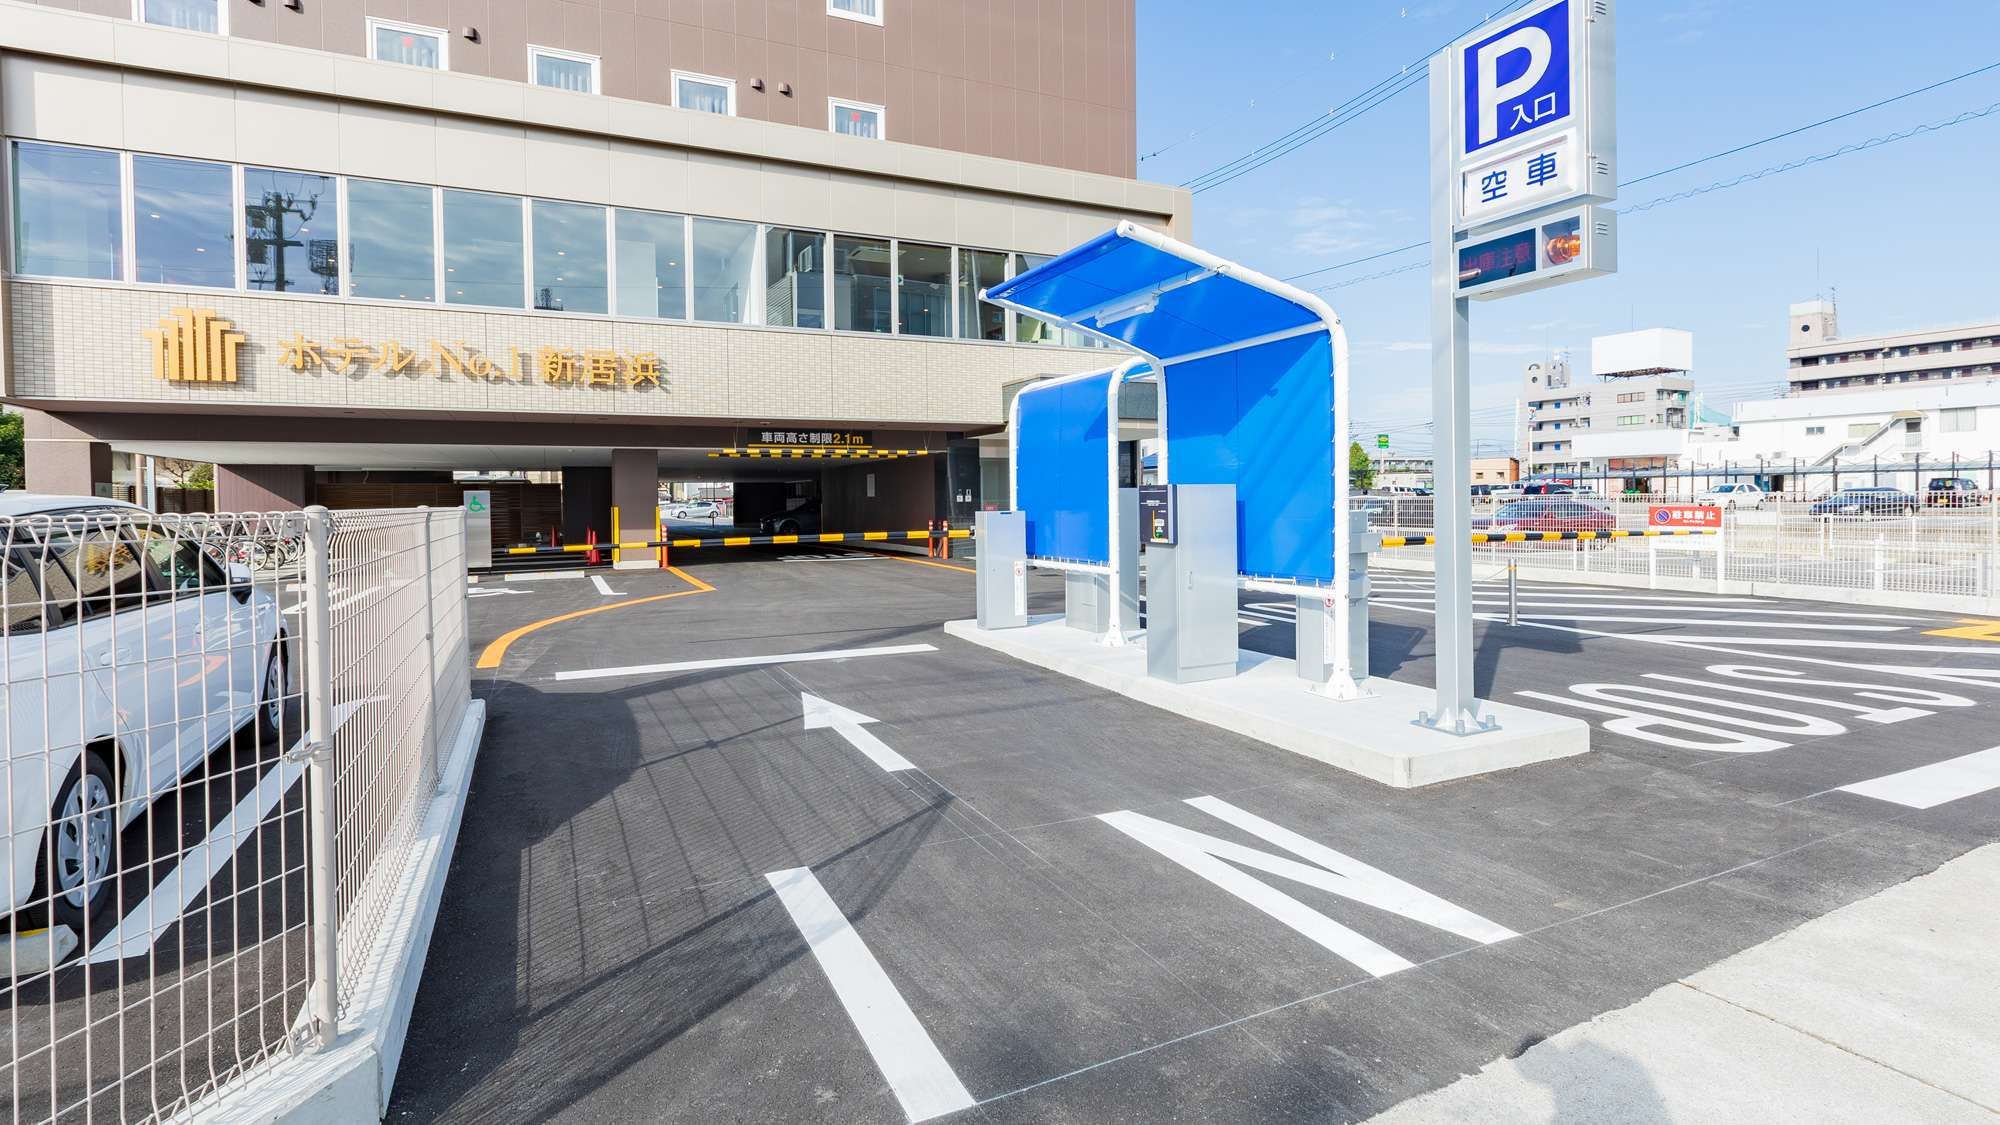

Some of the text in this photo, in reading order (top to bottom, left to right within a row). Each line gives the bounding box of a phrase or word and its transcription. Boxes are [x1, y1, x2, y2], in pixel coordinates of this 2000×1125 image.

[1477, 26, 1553, 146] P
[1510, 92, 1557, 131] 入口
[1481, 151, 1558, 203] 空車
[1672, 510, 1716, 520] 駐車禁止
